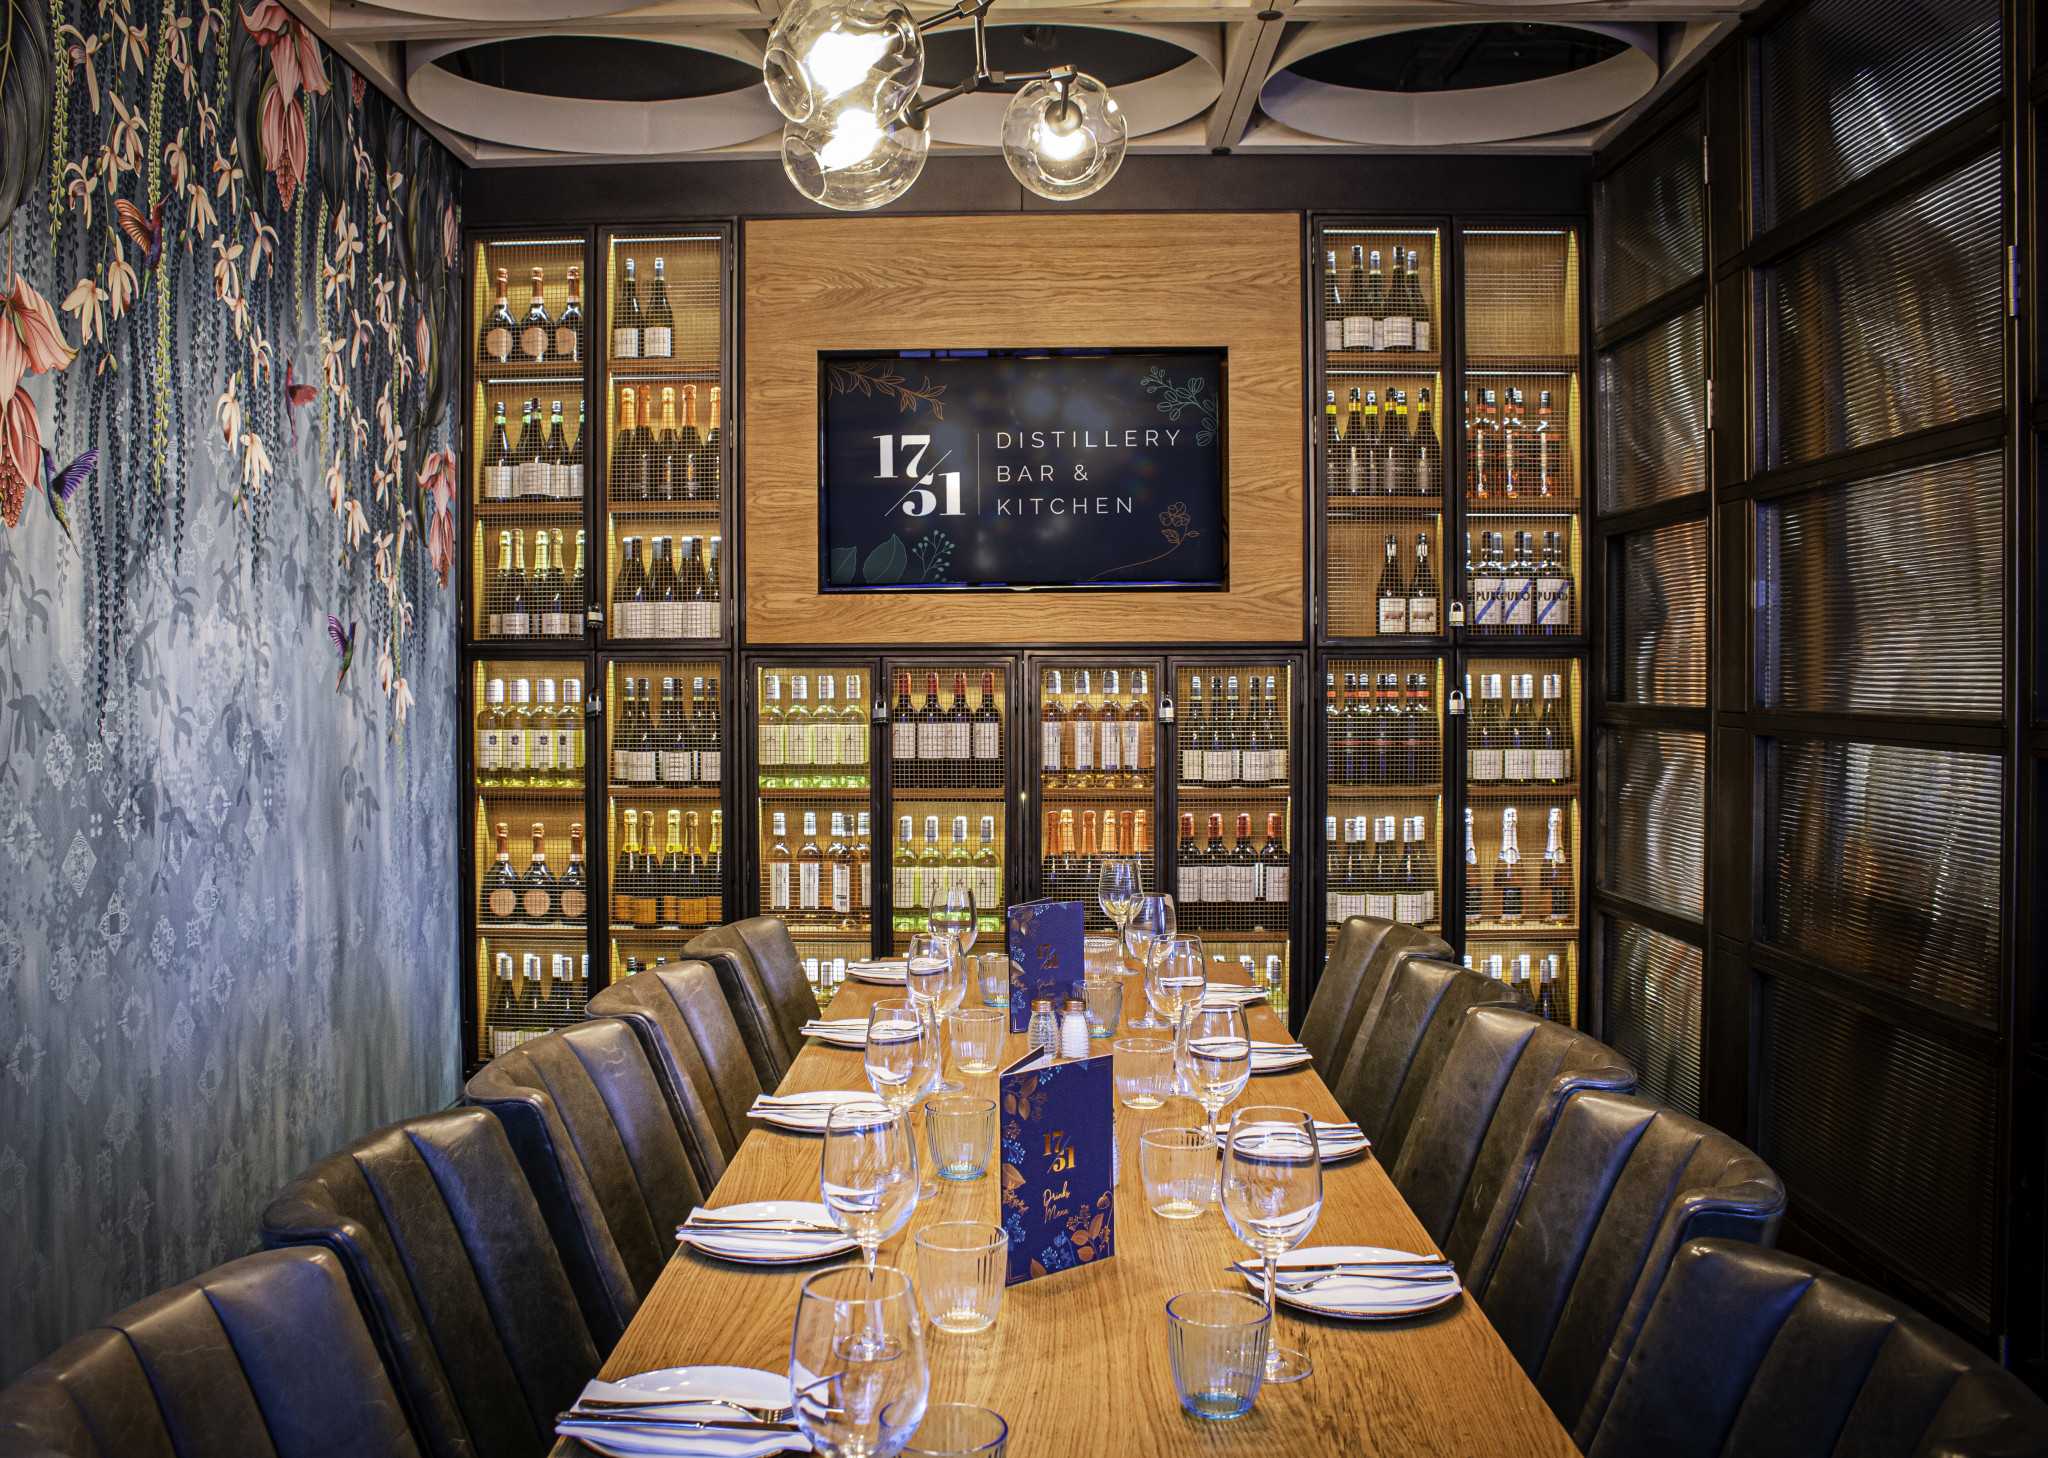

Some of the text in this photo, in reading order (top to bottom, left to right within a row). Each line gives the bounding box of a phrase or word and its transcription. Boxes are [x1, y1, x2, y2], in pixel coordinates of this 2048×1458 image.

[996, 429, 1181, 449] DISTILLERY
[997, 464, 1089, 483] BAR &
[997, 497, 1133, 516] KITCHEN
